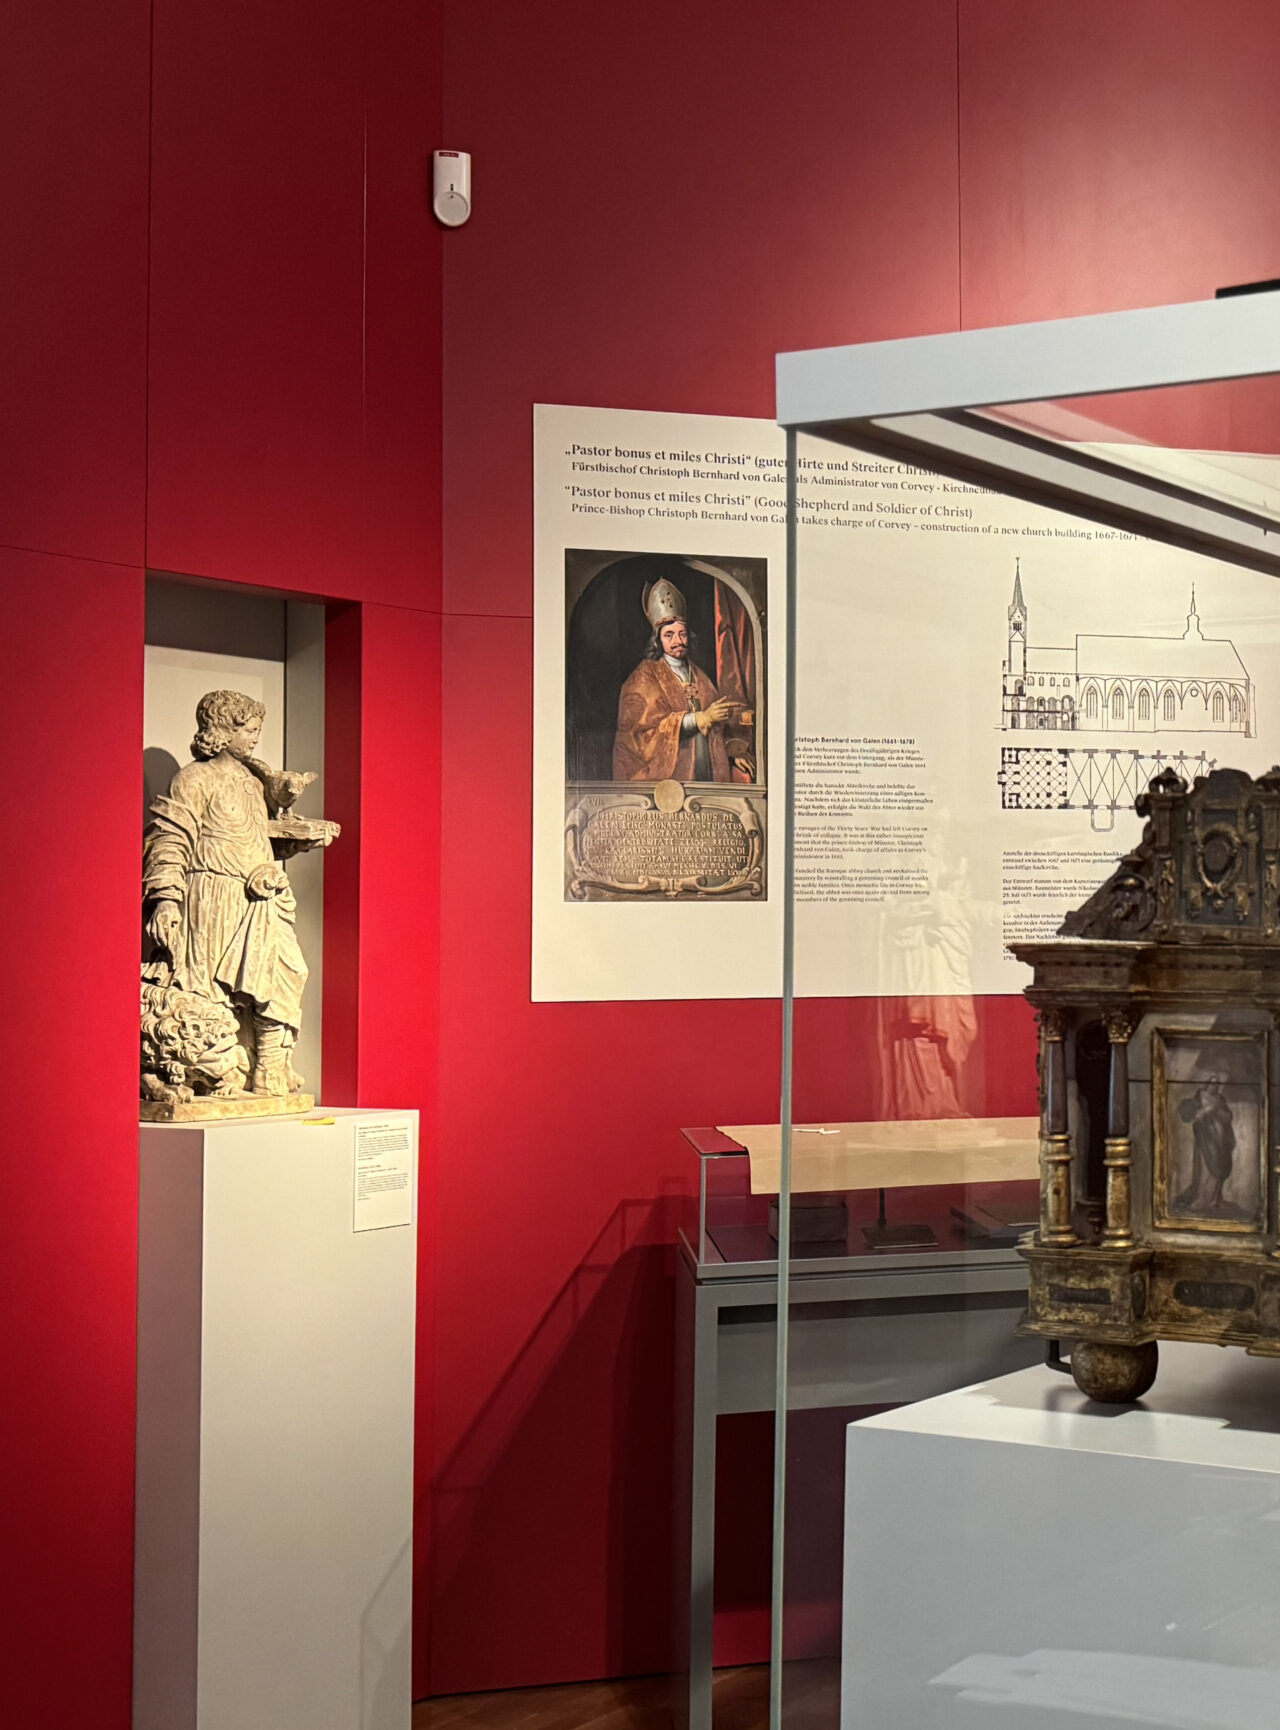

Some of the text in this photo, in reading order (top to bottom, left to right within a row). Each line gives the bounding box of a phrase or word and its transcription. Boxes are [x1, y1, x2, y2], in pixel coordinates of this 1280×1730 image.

[614, 446, 651, 460] bonus
[654, 449, 665, 461] et
[668, 450, 701, 463] miles
[826, 459, 848, 472] und
[851, 461, 894, 474] Streiter
[572, 461, 636, 475] Fürstbischof
[638, 465, 690, 481] Christoph
[692, 468, 740, 481] Bernhard
[742, 474, 760, 482] von
[762, 472, 787, 484] Gale
[810, 475, 878, 488] Administrator
[881, 482, 898, 490] von
[900, 479, 934, 495] Corvey
[614, 487, 651, 501] bonus
[653, 489, 665, 502] et
[668, 490, 701, 503] miles
[851, 500, 873, 512] and
[875, 501, 917, 515] Soldier
[919, 503, 931, 516] of
[934, 504, 973, 521] Christ)
[571, 502, 645, 519] Prince-Bishop
[647, 506, 698, 522] Christoph
[700, 509, 748, 522] Bernhard
[750, 515, 768, 523] von
[801, 514, 829, 526] takes
[830, 516, 863, 531] charge
[865, 518, 875, 528] of
[877, 518, 911, 533] Corvey
[920, 520, 980, 534] construction
[981, 524, 991, 534] of
[1021, 526, 1052, 537] church
[1054, 527, 1091, 542] building
